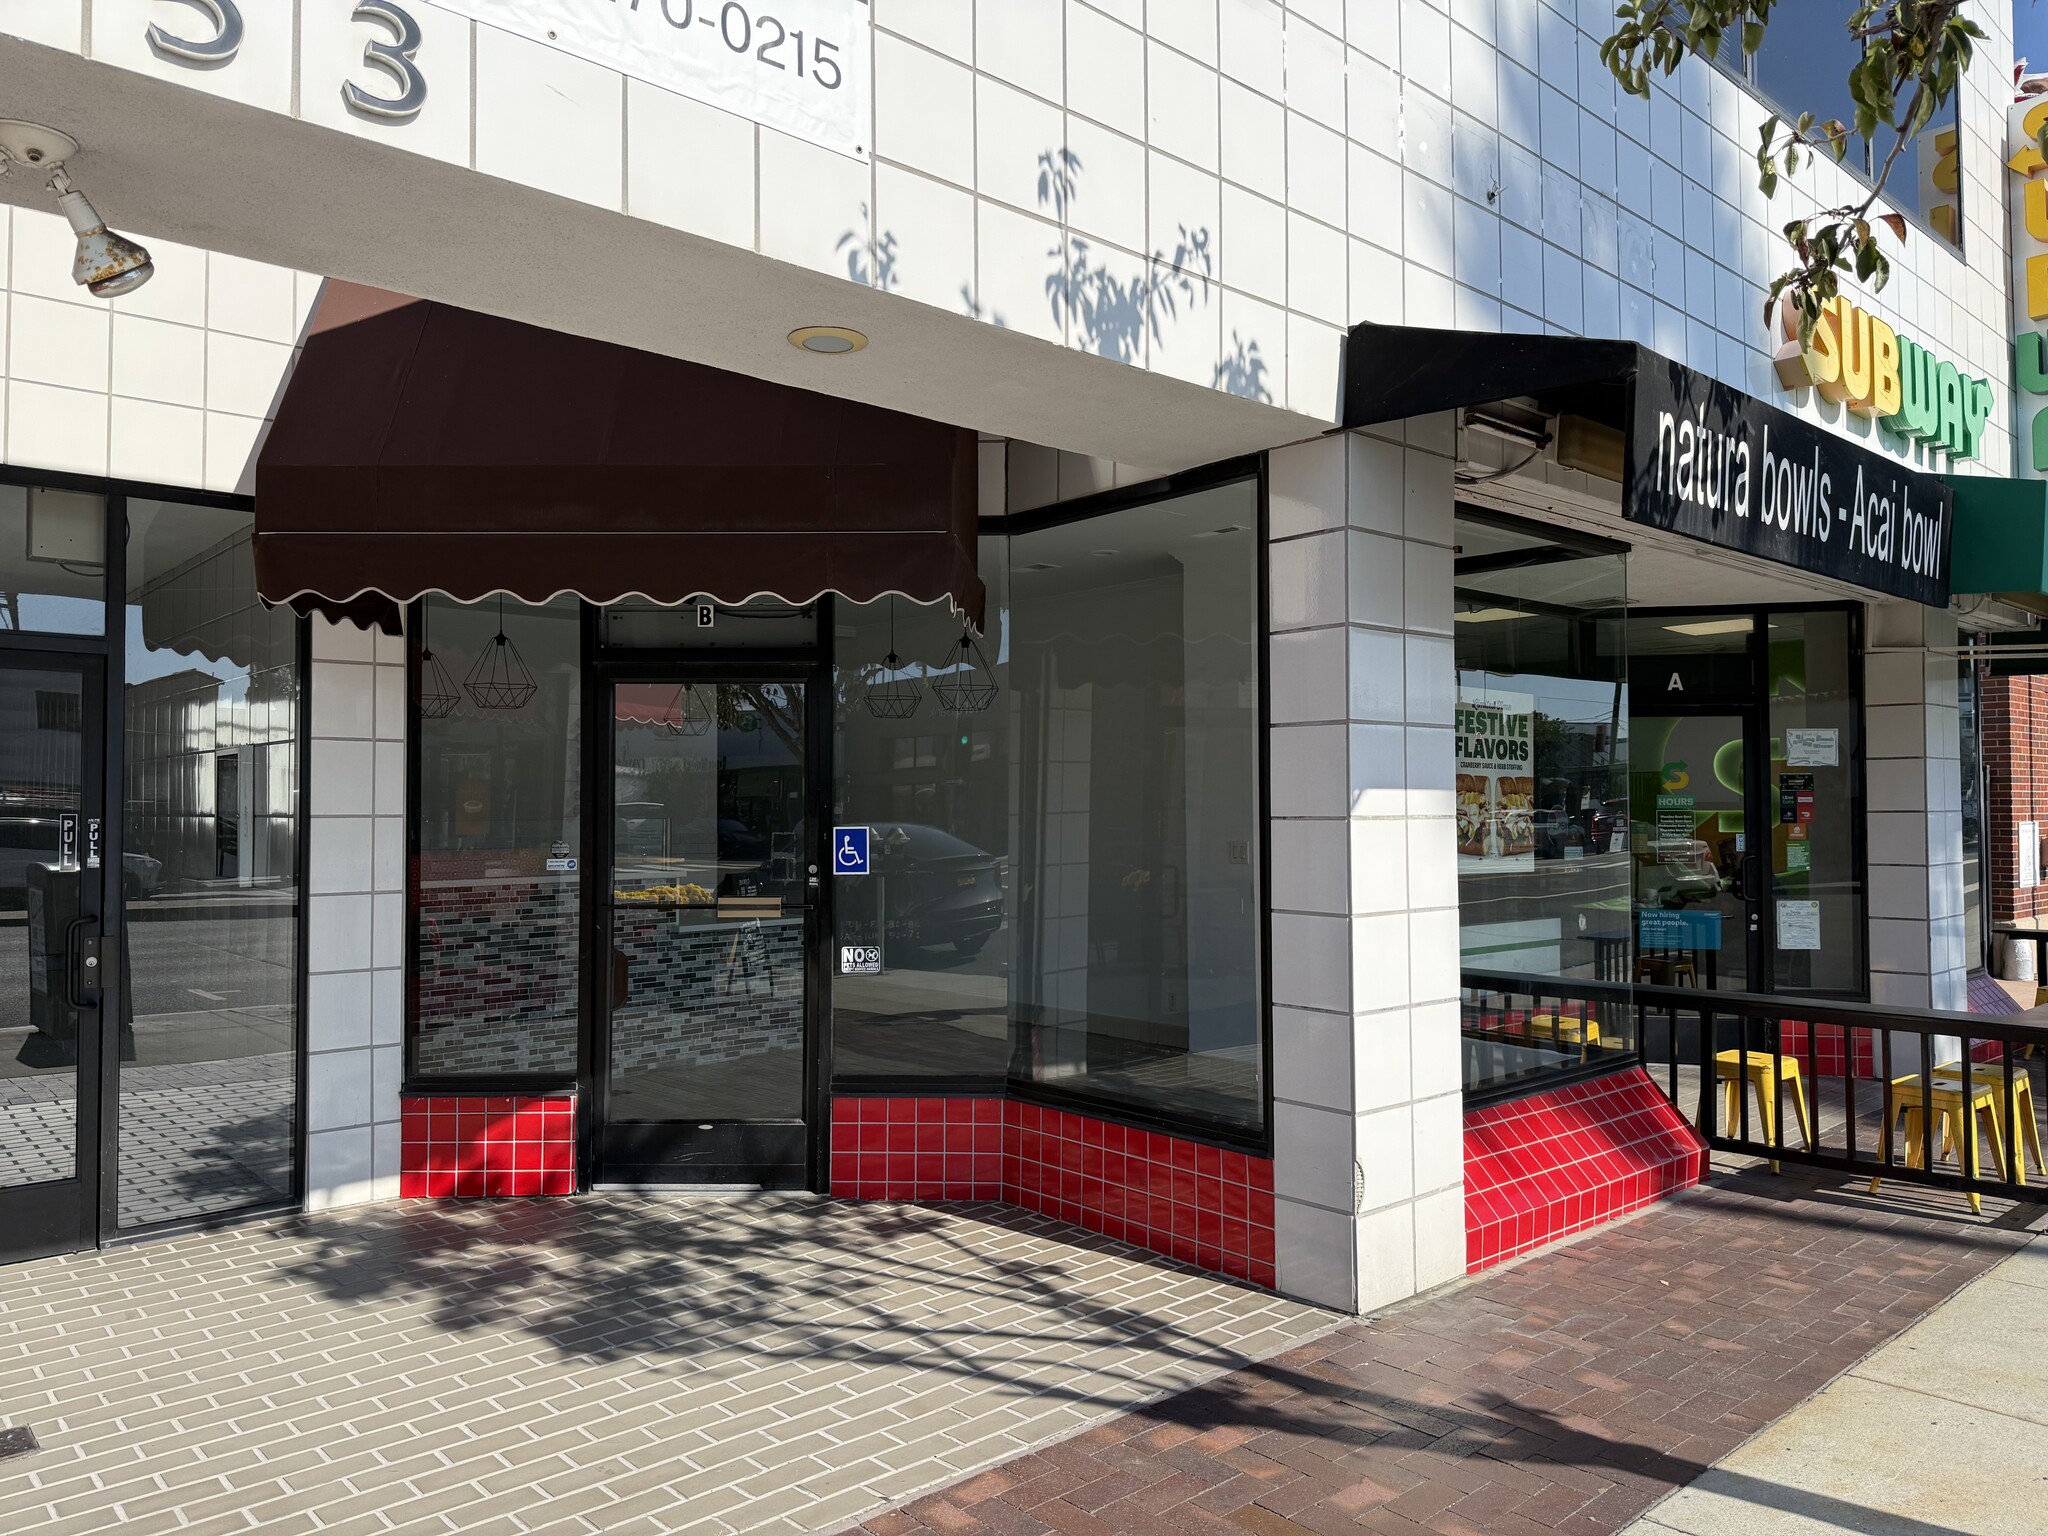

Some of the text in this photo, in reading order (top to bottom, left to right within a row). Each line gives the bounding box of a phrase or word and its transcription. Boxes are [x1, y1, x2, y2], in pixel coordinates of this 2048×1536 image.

[1773, 286, 1994, 462] SUBWAY
[1656, 401, 1750, 518] natura
[1760, 424, 1832, 542] bowls
[1849, 464, 1896, 563] Acai
[1901, 485, 1944, 580] bowl
[699, 606, 712, 625] B
[1667, 672, 1684, 691] A
[1455, 709, 1528, 738] FESTIVE
[1455, 736, 1529, 762] FLAVORS
[1460, 761, 1482, 769] CRANBERRY
[1482, 762, 1494, 770] SAUCE
[1507, 763, 1523, 771] STUFFING
[1658, 798, 1694, 806] HOURS
[63, 819, 74, 867] PULL
[89, 823, 99, 858] PULL
[1659, 911, 1680, 920] hiring
[1661, 919, 1689, 927] people.
[843, 948, 865, 963] NO
